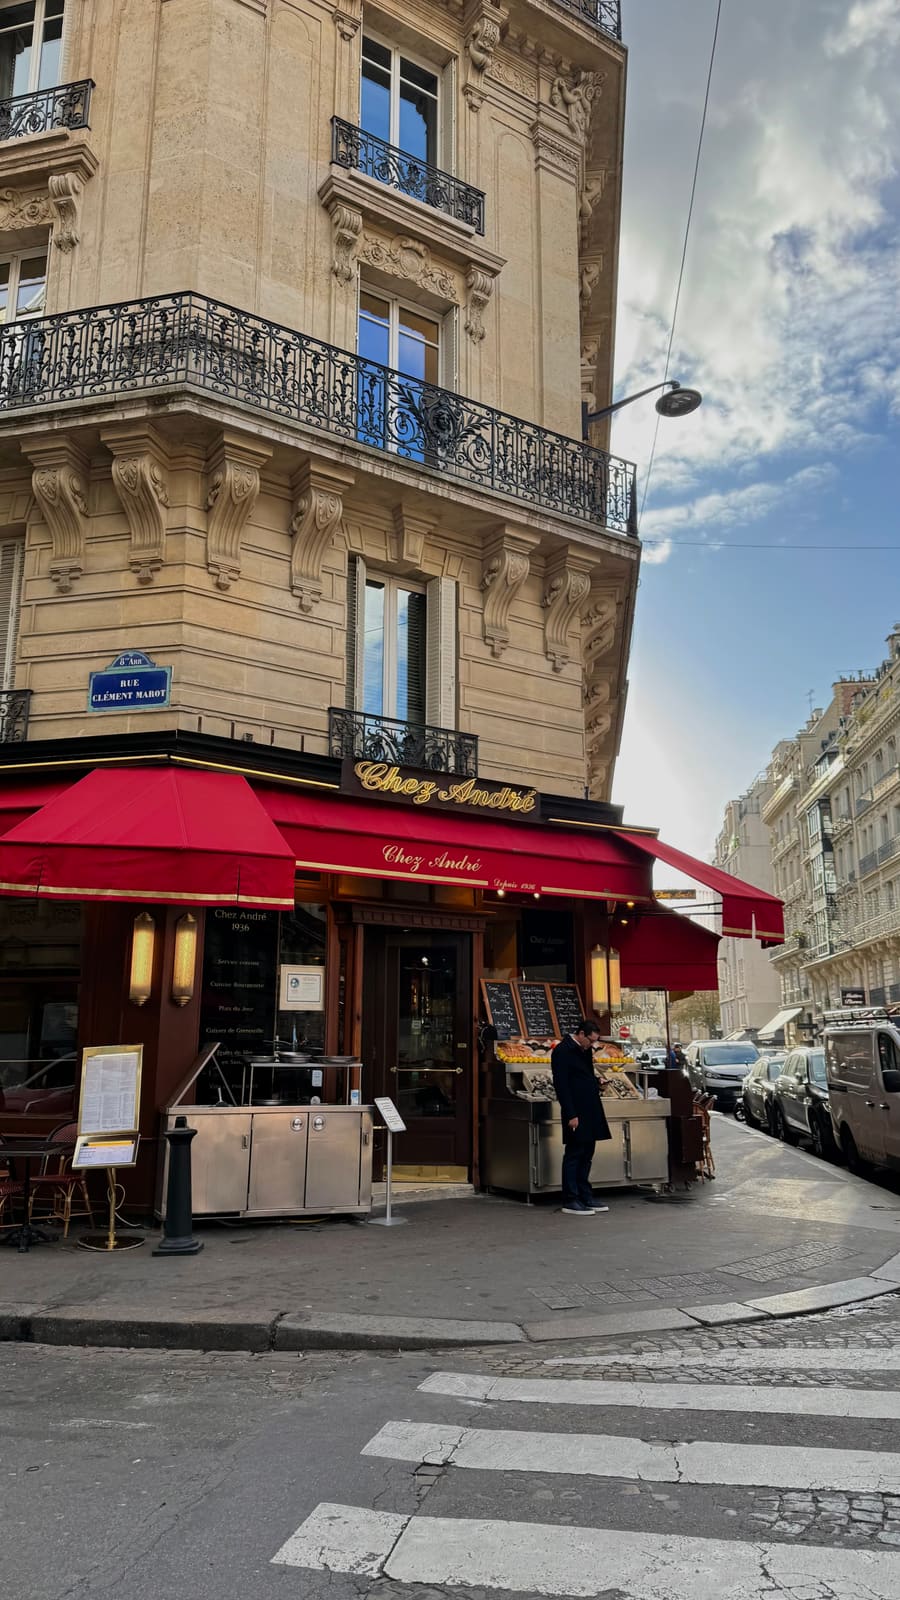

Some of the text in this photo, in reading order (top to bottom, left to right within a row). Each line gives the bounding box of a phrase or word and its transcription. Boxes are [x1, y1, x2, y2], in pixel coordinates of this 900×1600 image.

[120, 679, 140, 688] RUE
[92, 689, 166, 702] CLÉMENT MAROT
[354, 761, 538, 814] Chez André
[382, 844, 484, 873] Chez André
[493, 877, 518, 890] Depuis
[214, 909, 267, 921] Chez André
[231, 922, 250, 932] 1936
